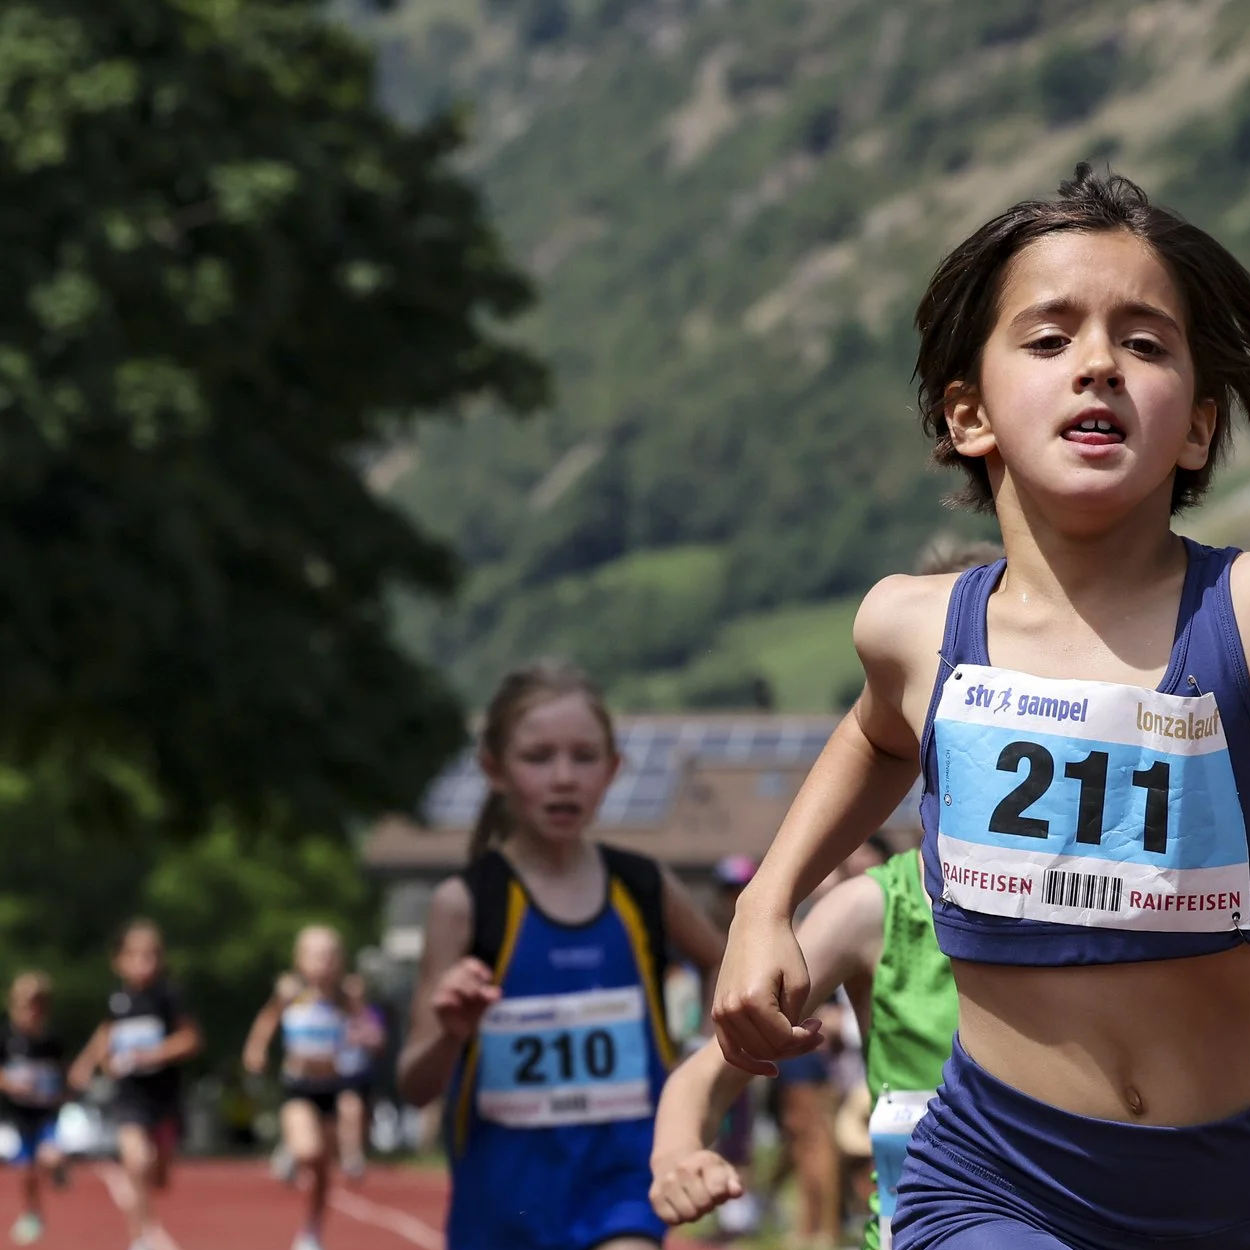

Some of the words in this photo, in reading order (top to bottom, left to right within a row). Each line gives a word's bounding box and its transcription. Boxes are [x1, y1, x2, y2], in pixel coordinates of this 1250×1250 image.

[964, 684, 996, 709] stv
[1017, 693, 1089, 723] gampel
[1136, 702, 1220, 741] lonzalauf
[987, 740, 1171, 855] 211
[943, 862, 1033, 896] RAIFFEISEN
[1129, 890, 1241, 912] RAIFFEISEN
[512, 1028, 617, 1086] 210
